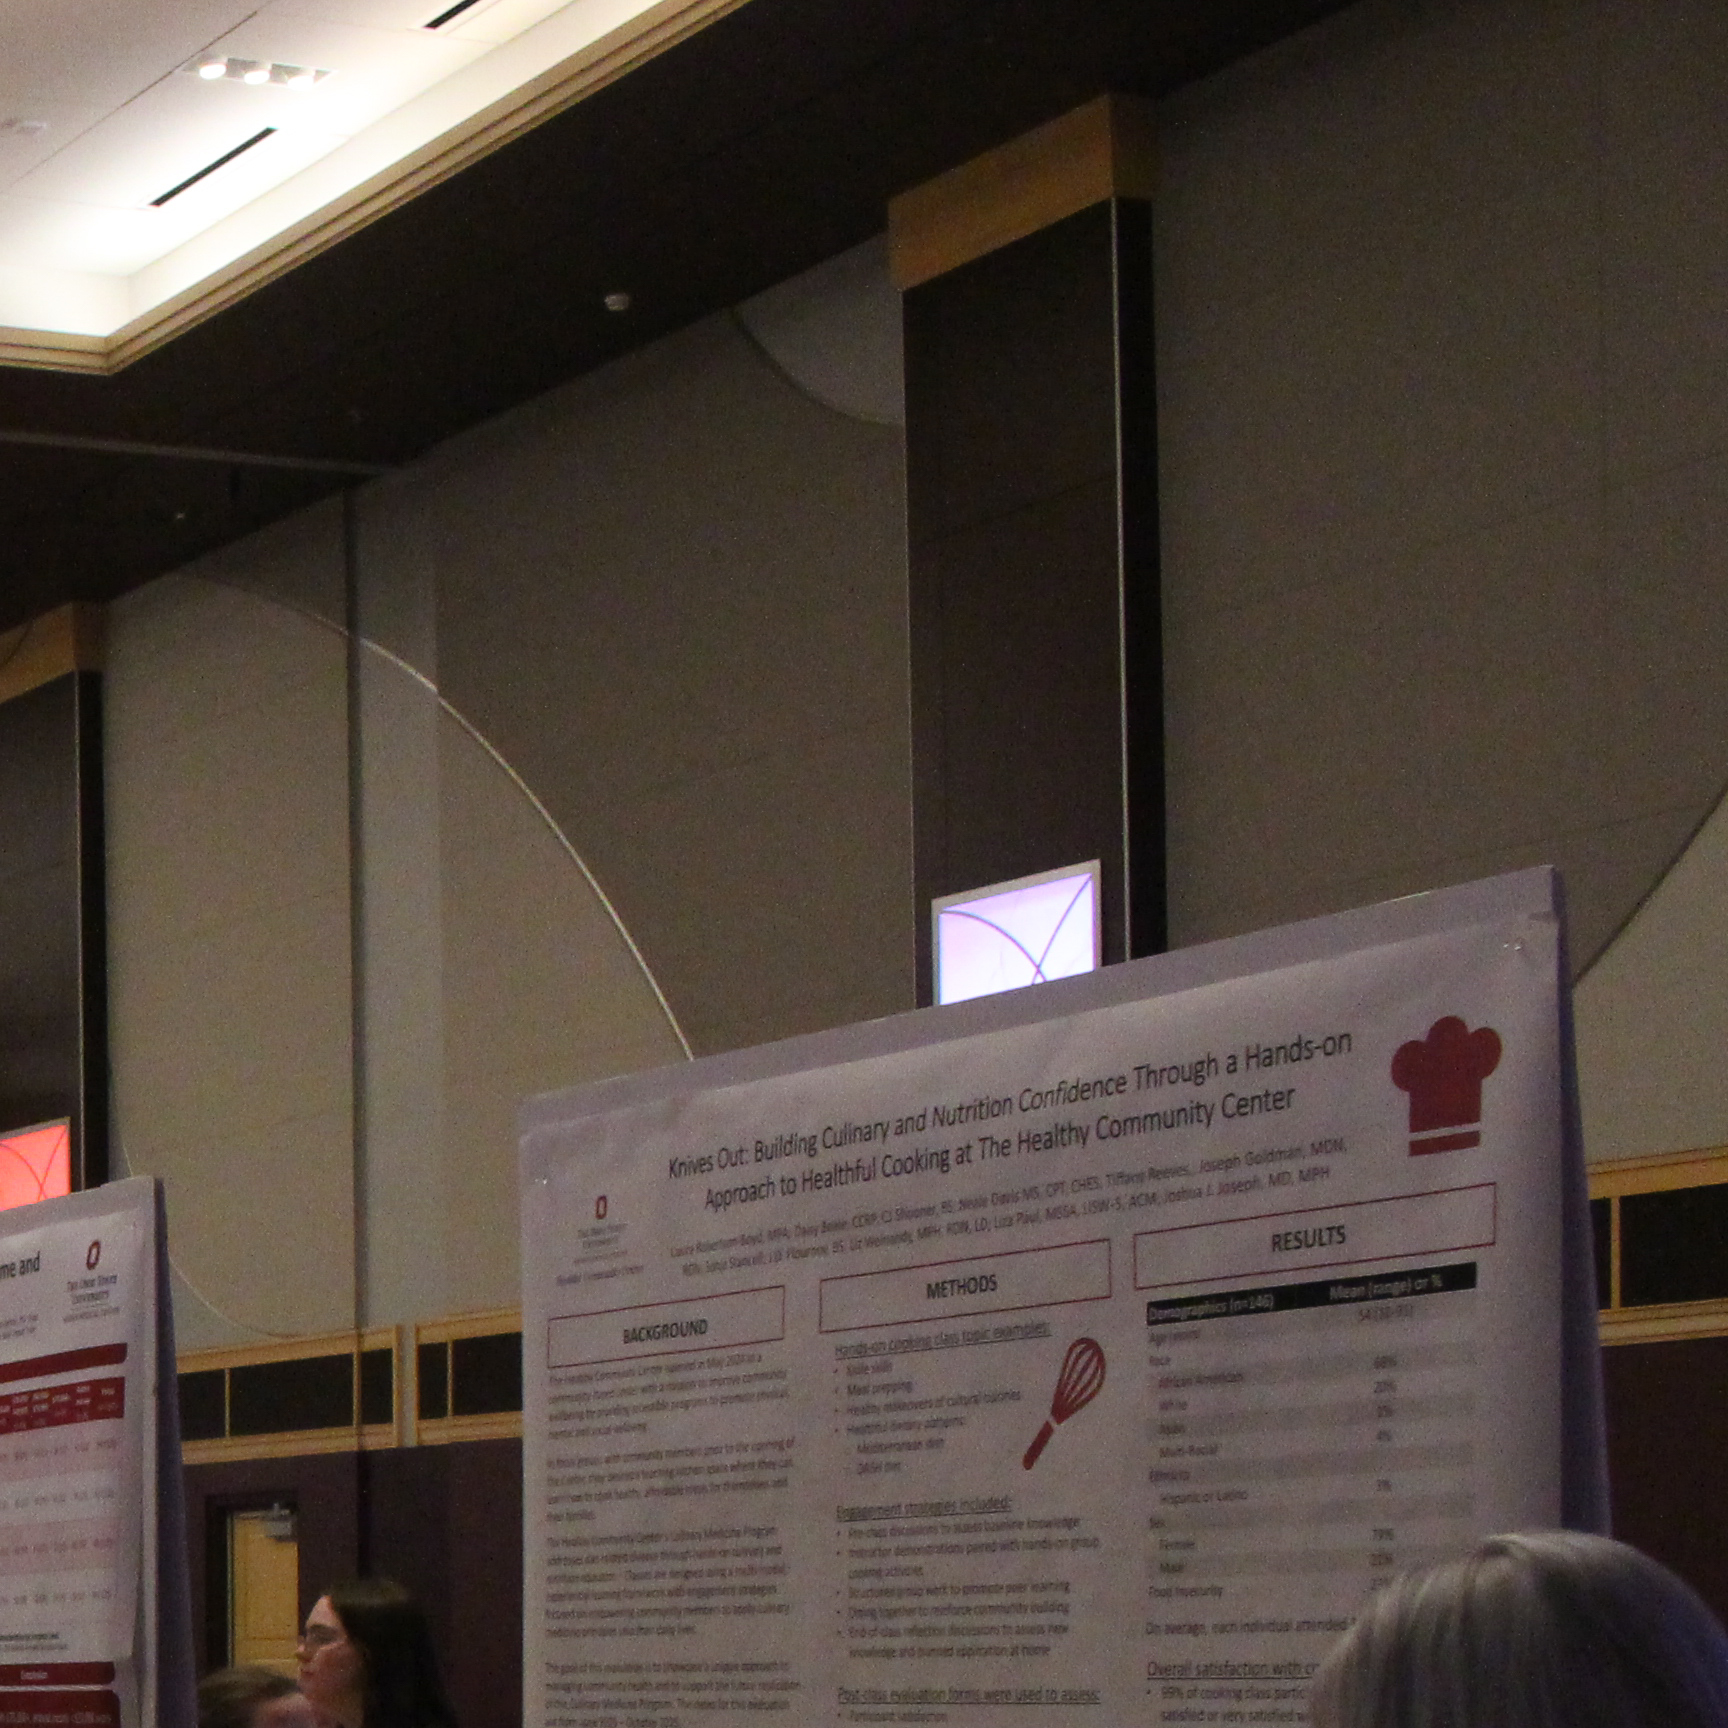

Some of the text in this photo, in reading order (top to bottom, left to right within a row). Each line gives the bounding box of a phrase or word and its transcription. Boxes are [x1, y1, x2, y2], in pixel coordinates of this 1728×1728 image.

[668, 1032, 1352, 1178] Knives Out: Building Culinary and Nutrition Confidence Through a Hands-on
[705, 1086, 1296, 1213] Approach to Healthful Cooking at The Healthy Community Center
[1271, 1225, 1346, 1252] RESULTS
[19, 1252, 40, 1275] and
[927, 1275, 998, 1299] METHODS
[623, 1318, 708, 1344] BACKGROUND
[1147, 1660, 1192, 1676] Overall
[1196, 1660, 1267, 1676] satisfaction
